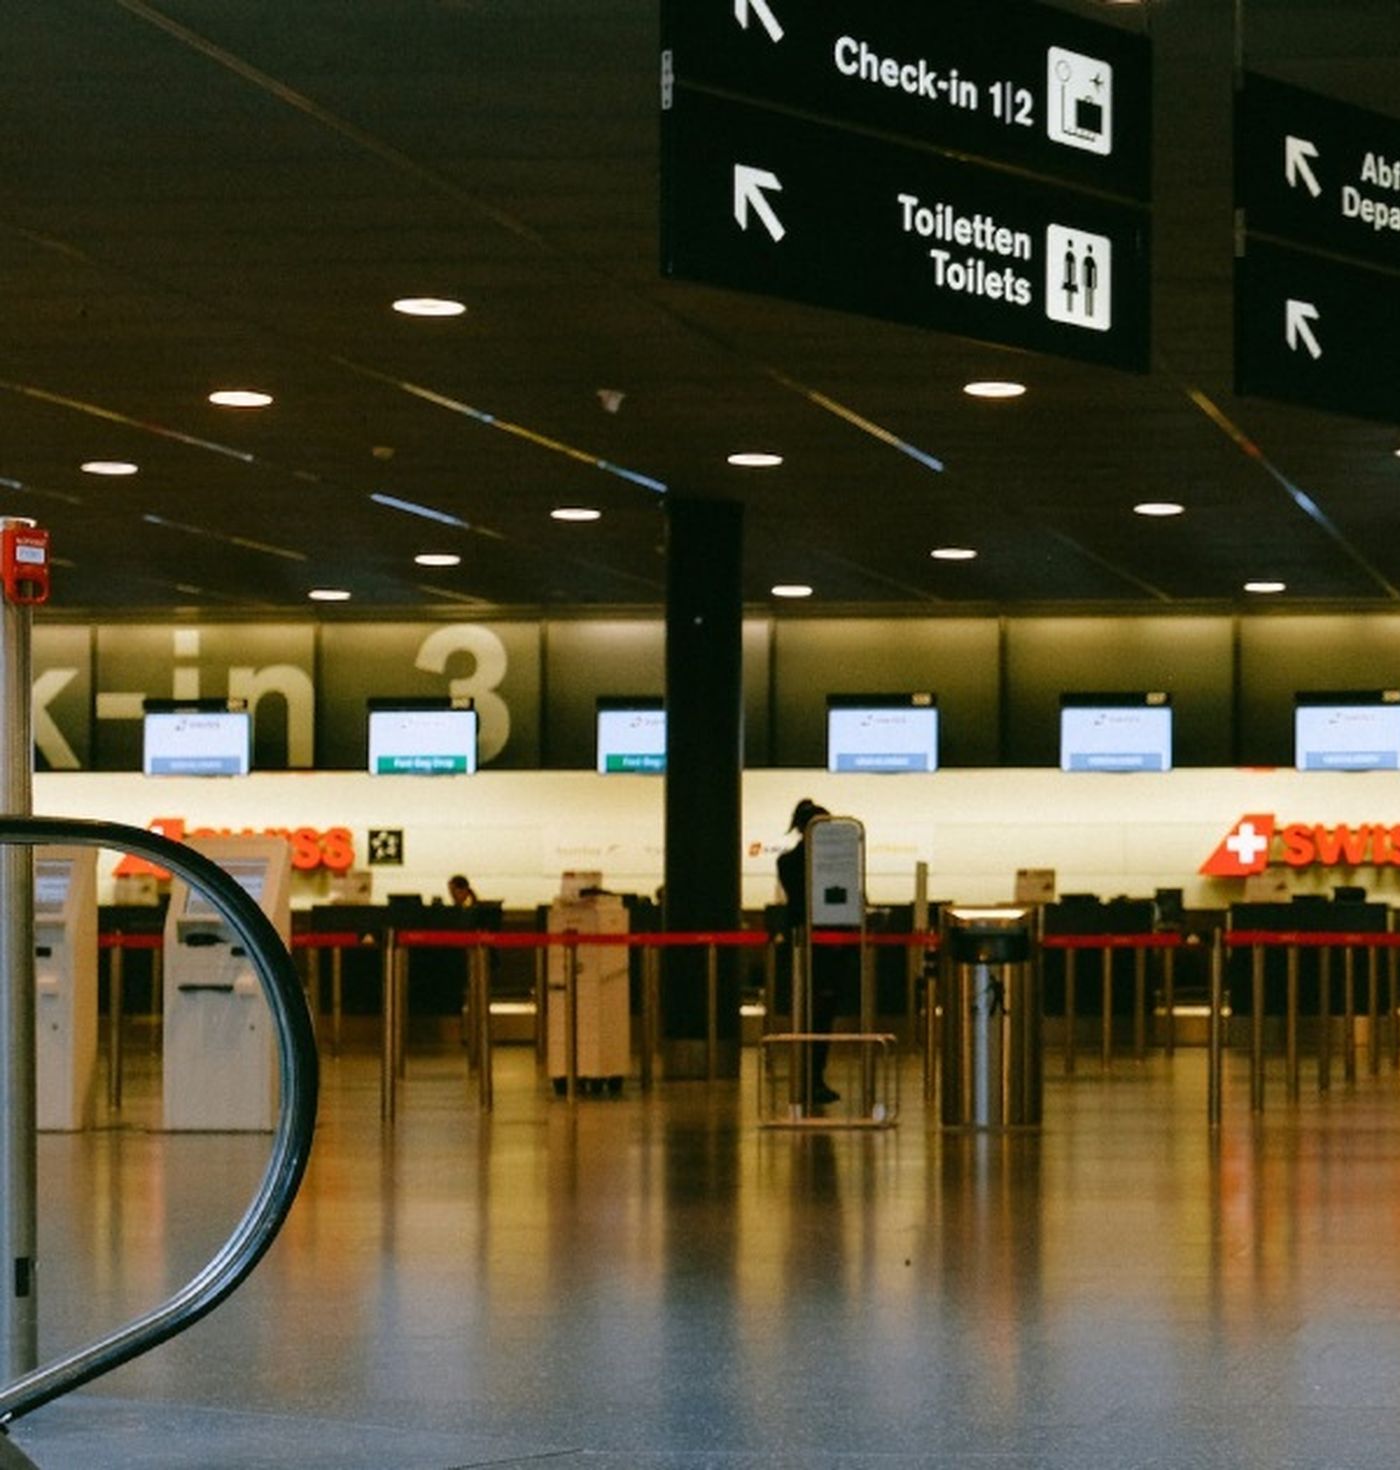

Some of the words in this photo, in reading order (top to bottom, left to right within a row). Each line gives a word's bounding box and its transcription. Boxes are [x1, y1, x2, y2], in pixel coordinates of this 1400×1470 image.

[834, 35, 978, 110] Check-in
[897, 193, 1032, 262] Toiletten
[930, 248, 1032, 306] Toilets
[415, 624, 510, 764] 3
